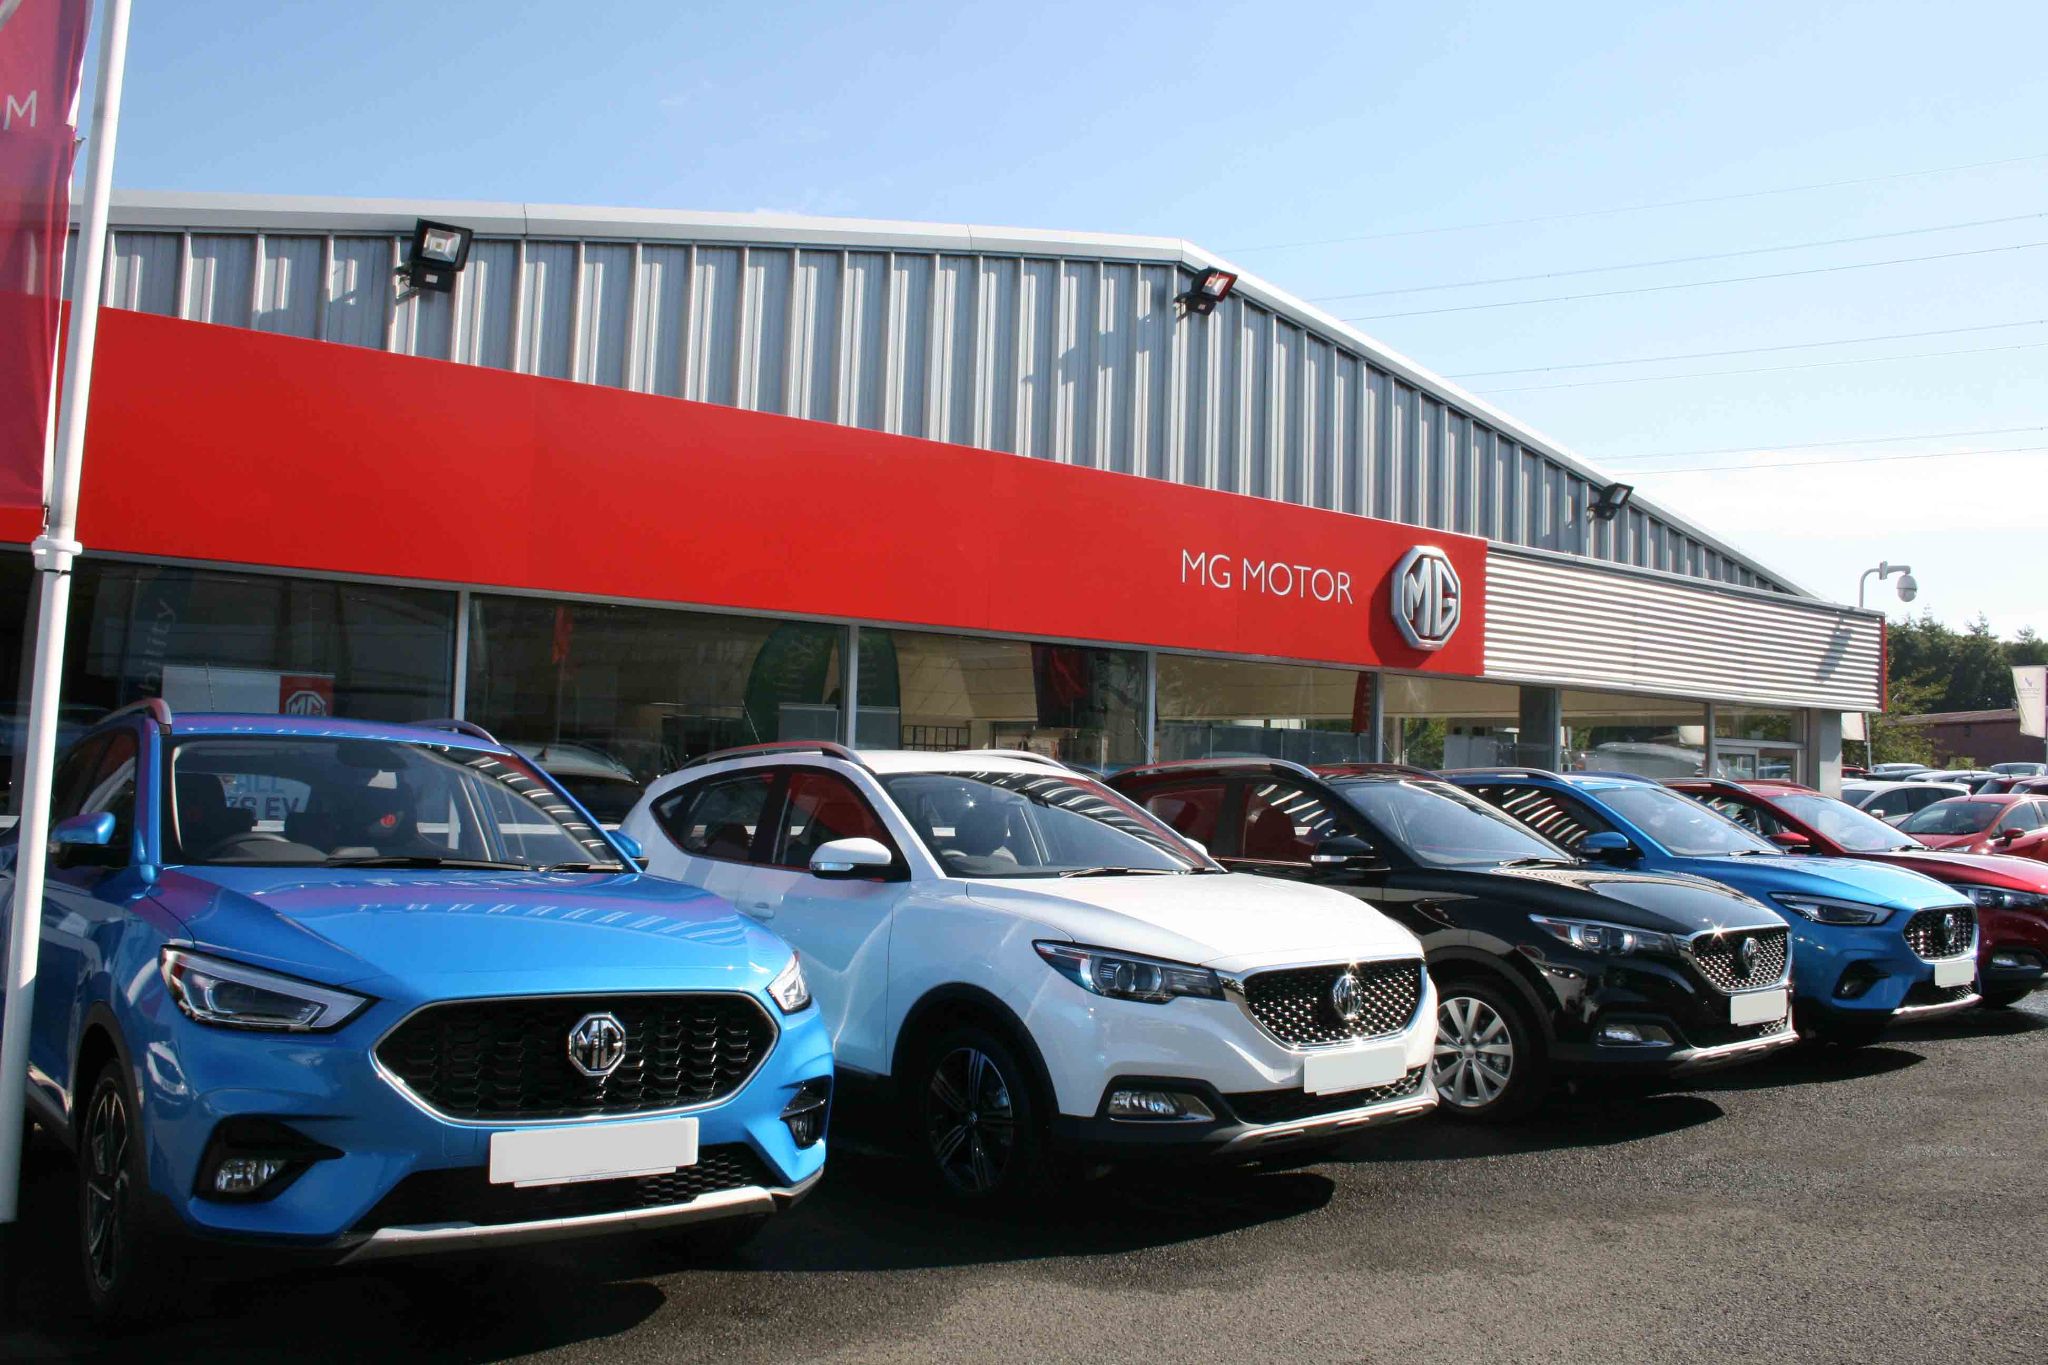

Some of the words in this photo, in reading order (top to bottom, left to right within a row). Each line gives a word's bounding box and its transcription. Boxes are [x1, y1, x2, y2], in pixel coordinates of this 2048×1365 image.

[1182, 549, 1231, 589] MG
[1242, 557, 1353, 604] MOTOR
[1403, 557, 1457, 636] MG
[576, 1020, 623, 1069] MG
